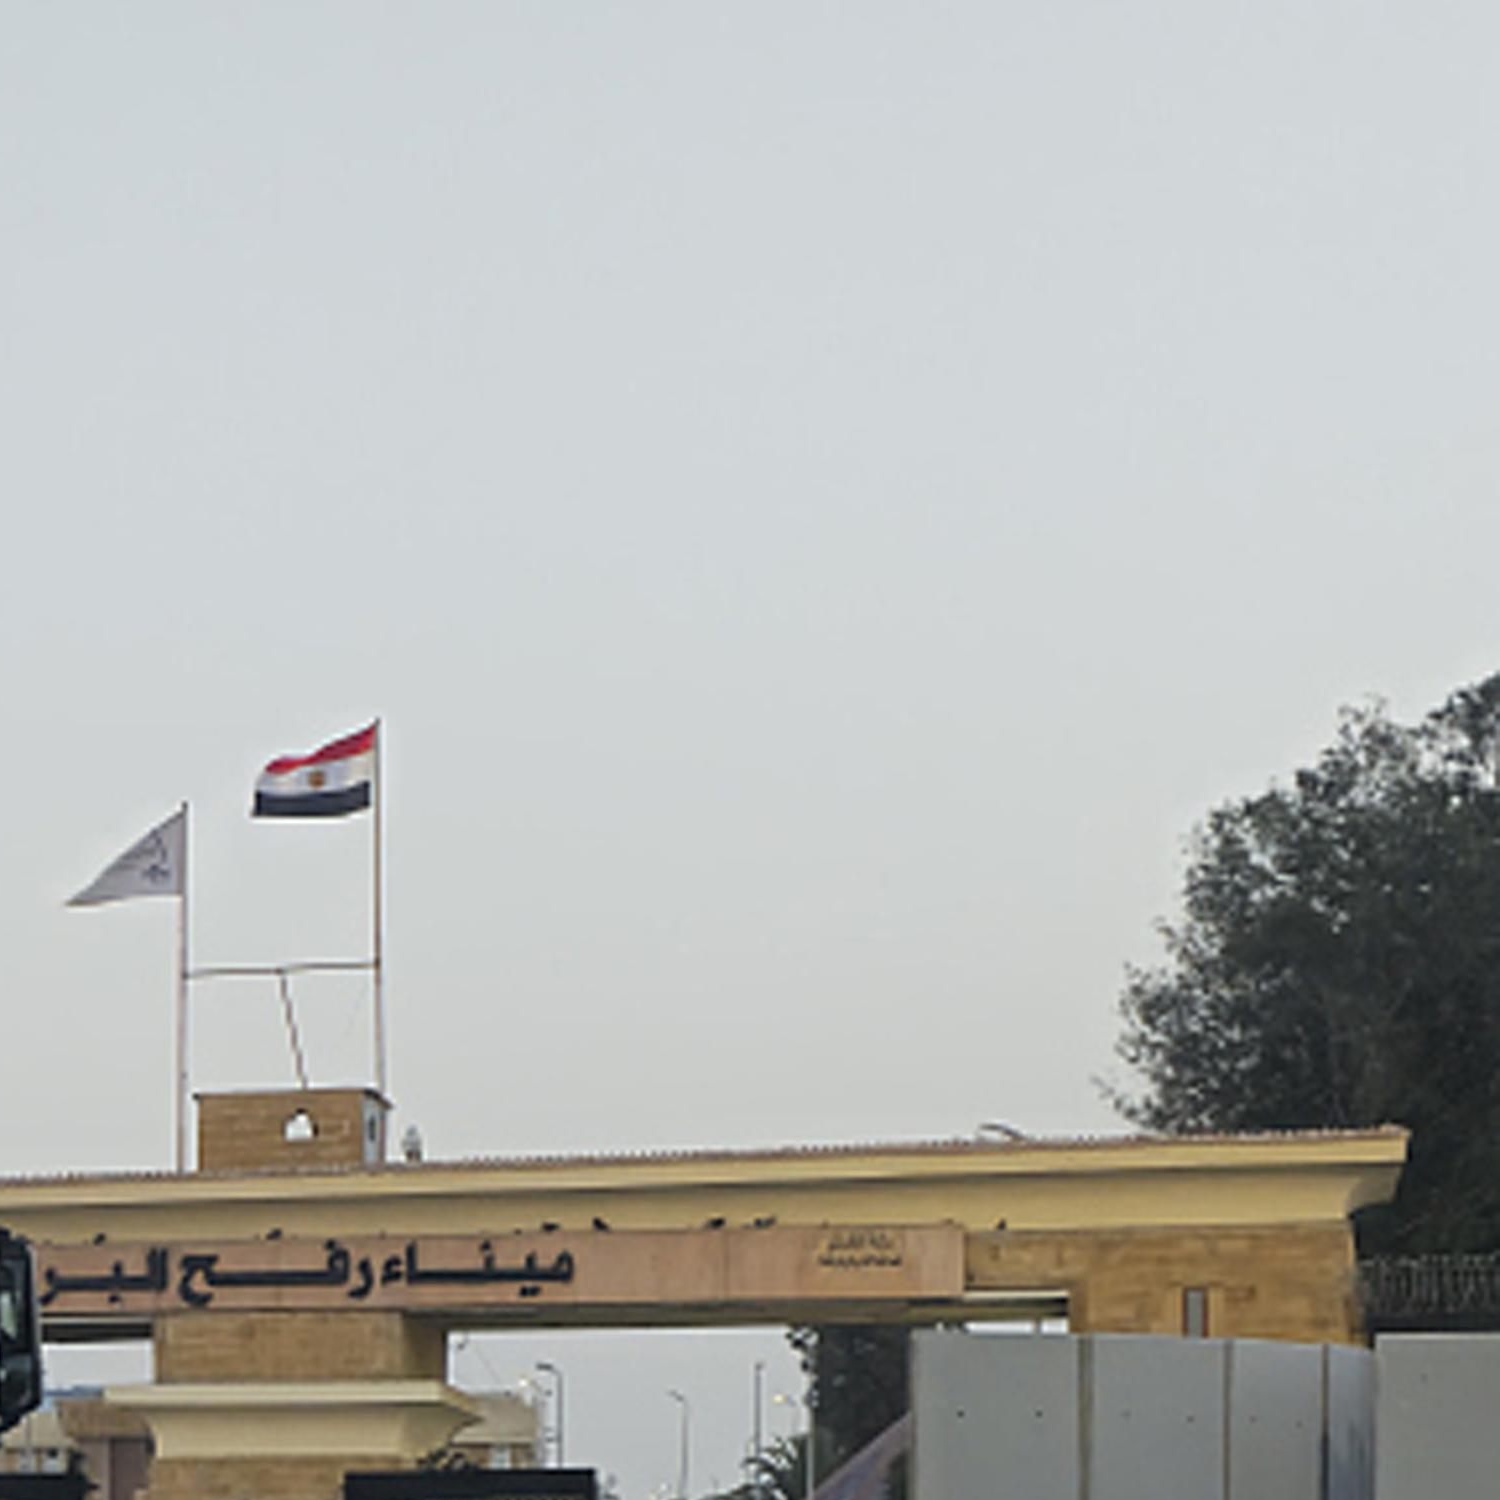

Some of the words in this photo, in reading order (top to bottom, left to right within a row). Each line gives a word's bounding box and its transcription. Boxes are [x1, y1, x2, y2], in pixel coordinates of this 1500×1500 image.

[38, 1247, 169, 1306] البر
[177, 1238, 374, 1306] رفح
[381, 1239, 575, 1298] ميناء
